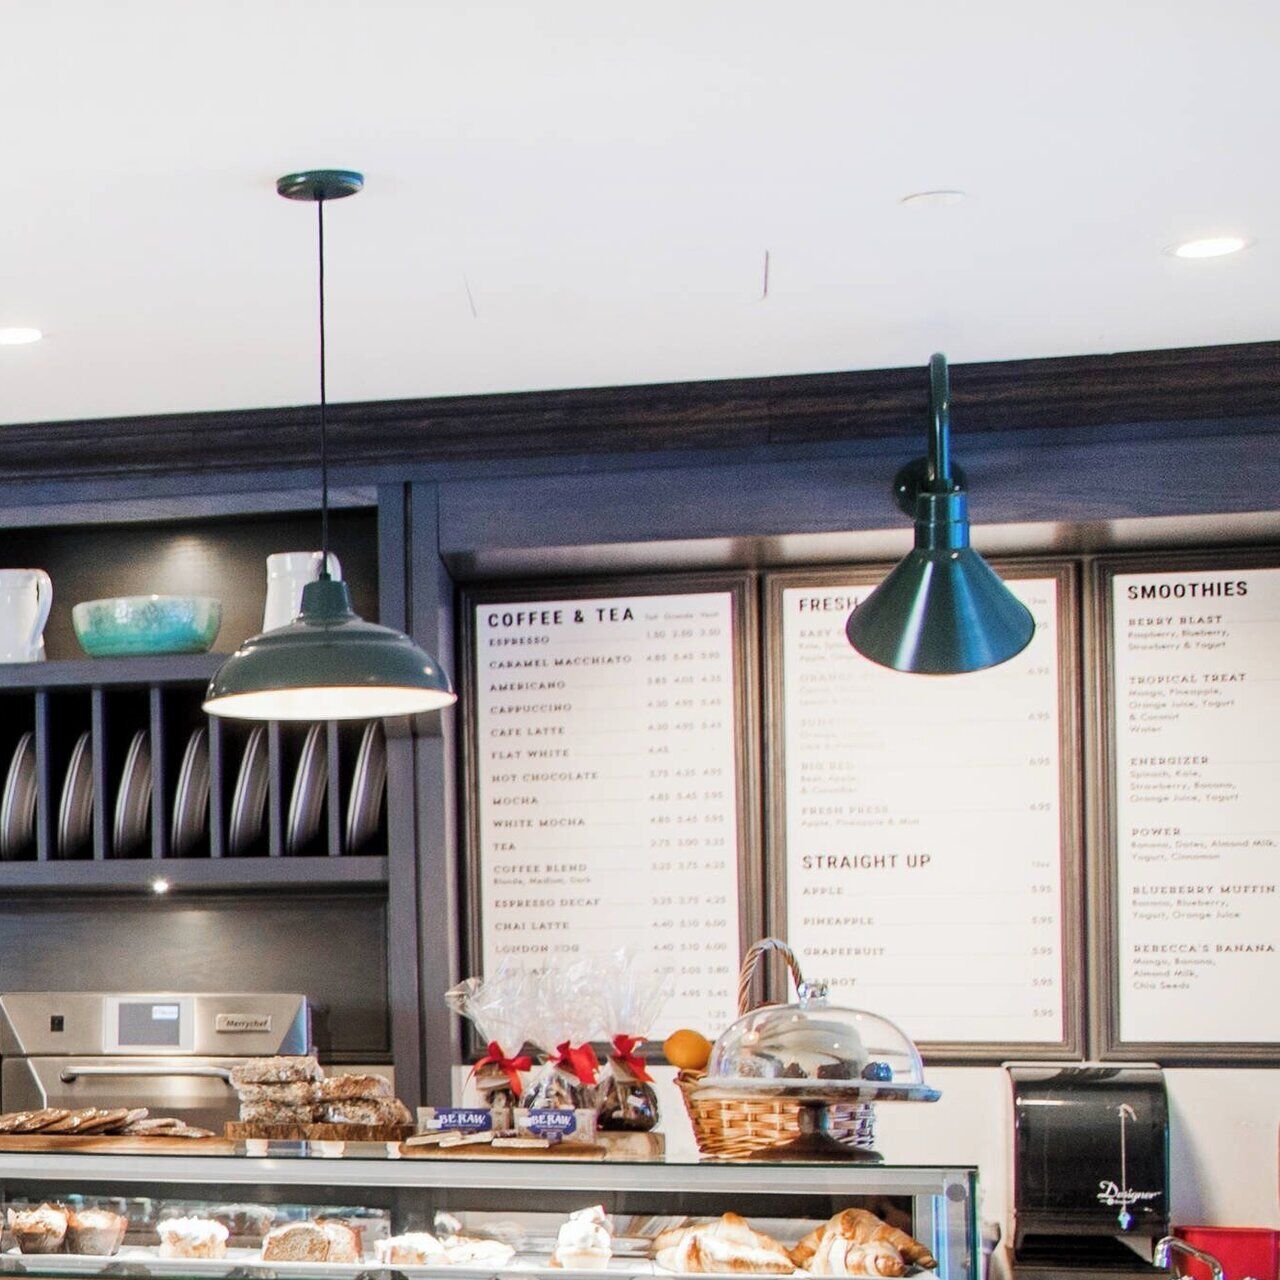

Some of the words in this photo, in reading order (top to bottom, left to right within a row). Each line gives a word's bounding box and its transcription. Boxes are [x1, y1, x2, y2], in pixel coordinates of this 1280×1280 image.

[1128, 581, 1247, 599] SMOOTHIES
[488, 611, 561, 627] COFFEE
[574, 610, 583, 622] &
[597, 608, 633, 621] TEA
[1129, 617, 1172, 626] BERRY
[1180, 615, 1222, 624] BLAST
[489, 637, 549, 646] ESPRESSO
[489, 660, 546, 668] CARAMEL
[554, 656, 631, 666] MACCHIATO
[1129, 675, 1197, 684] TROPICAL
[1204, 674, 1246, 682] TREAT
[490, 682, 565, 691] AMERICANO
[490, 704, 571, 714] CAPPUCCINO
[527, 727, 564, 735] LATTE
[492, 751, 521, 759] FLAT
[1131, 757, 1208, 765] ENERGIZER
[492, 774, 517, 782] HOT
[523, 772, 597, 781] CHOCOLATE
[493, 797, 538, 805] MOCHA
[539, 818, 585, 827] MOCHA
[1132, 828, 1180, 836] POWER
[803, 855, 897, 868] STRAIGHT
[907, 855, 930, 867] UP
[494, 865, 540, 873] COFFEE
[546, 864, 587, 872] BLEND
[803, 887, 842, 895] APPLE
[1133, 886, 1213, 894] BLUEBERRY
[495, 900, 555, 908] ESPRESSO
[532, 922, 568, 930] LATTE
[226, 1018, 268, 1030] Merrychef
[1096, 1180, 1163, 1203] Designer
